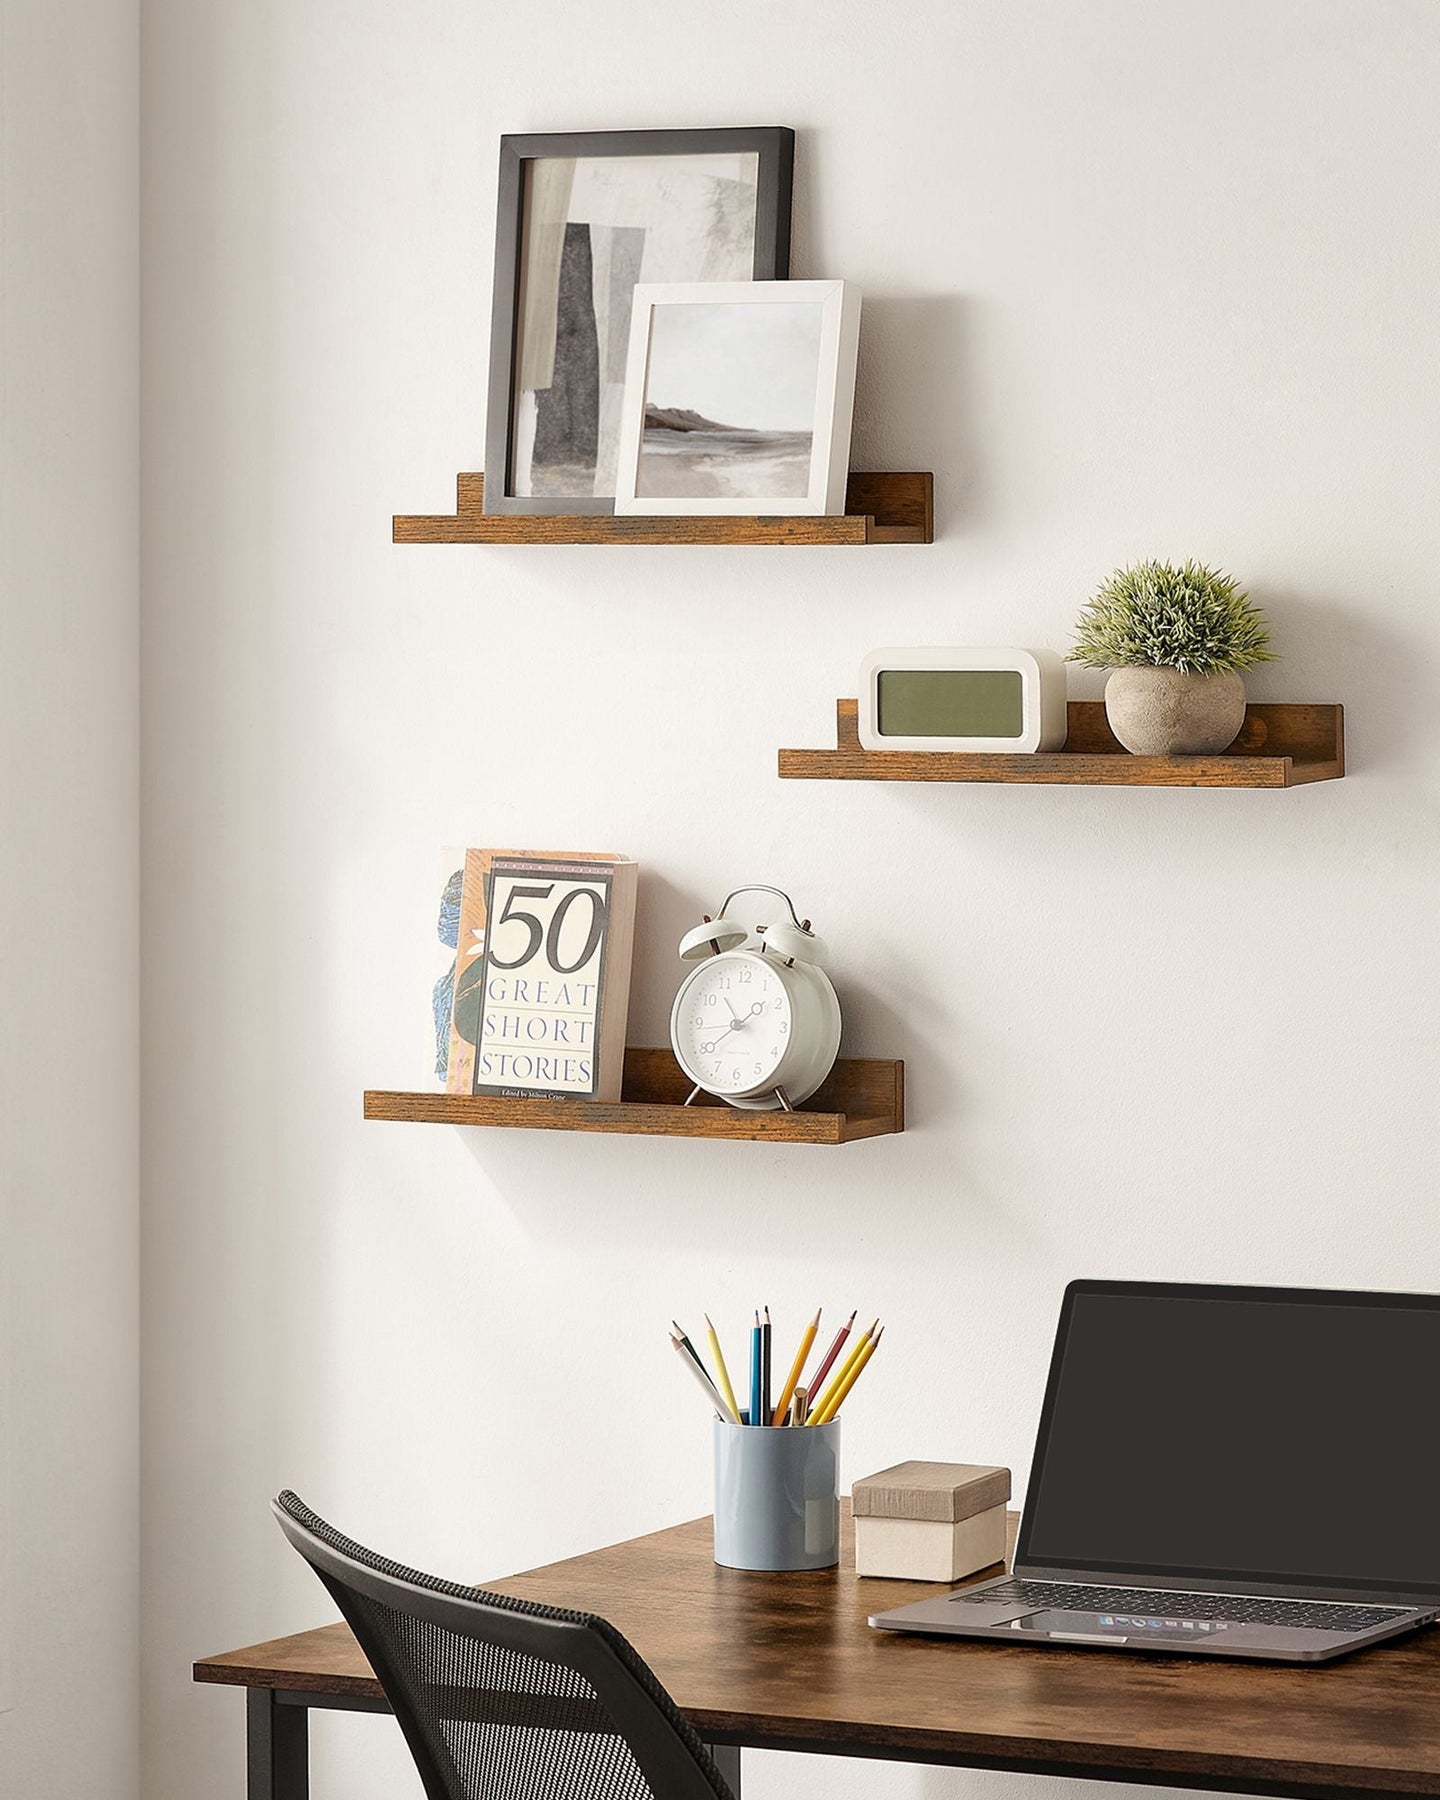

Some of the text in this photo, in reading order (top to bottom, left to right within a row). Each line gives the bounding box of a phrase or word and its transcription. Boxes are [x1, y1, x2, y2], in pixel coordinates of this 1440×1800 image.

[487, 884, 608, 974] 50
[738, 970, 752, 983] 12
[719, 977, 731, 989] 11
[762, 980, 768, 991] 1
[488, 977, 595, 1007] GREAT
[703, 994, 717, 1006] 10
[774, 998, 783, 1010] 2
[484, 1014, 593, 1043] SHORT
[695, 1017, 703, 1029] 9
[779, 1022, 788, 1034] 3
[770, 1046, 778, 1058] 4
[480, 1052, 591, 1084] STORIES
[714, 1061, 722, 1073] 7
[753, 1063, 762, 1075] 5
[732, 1067, 741, 1080] 6
